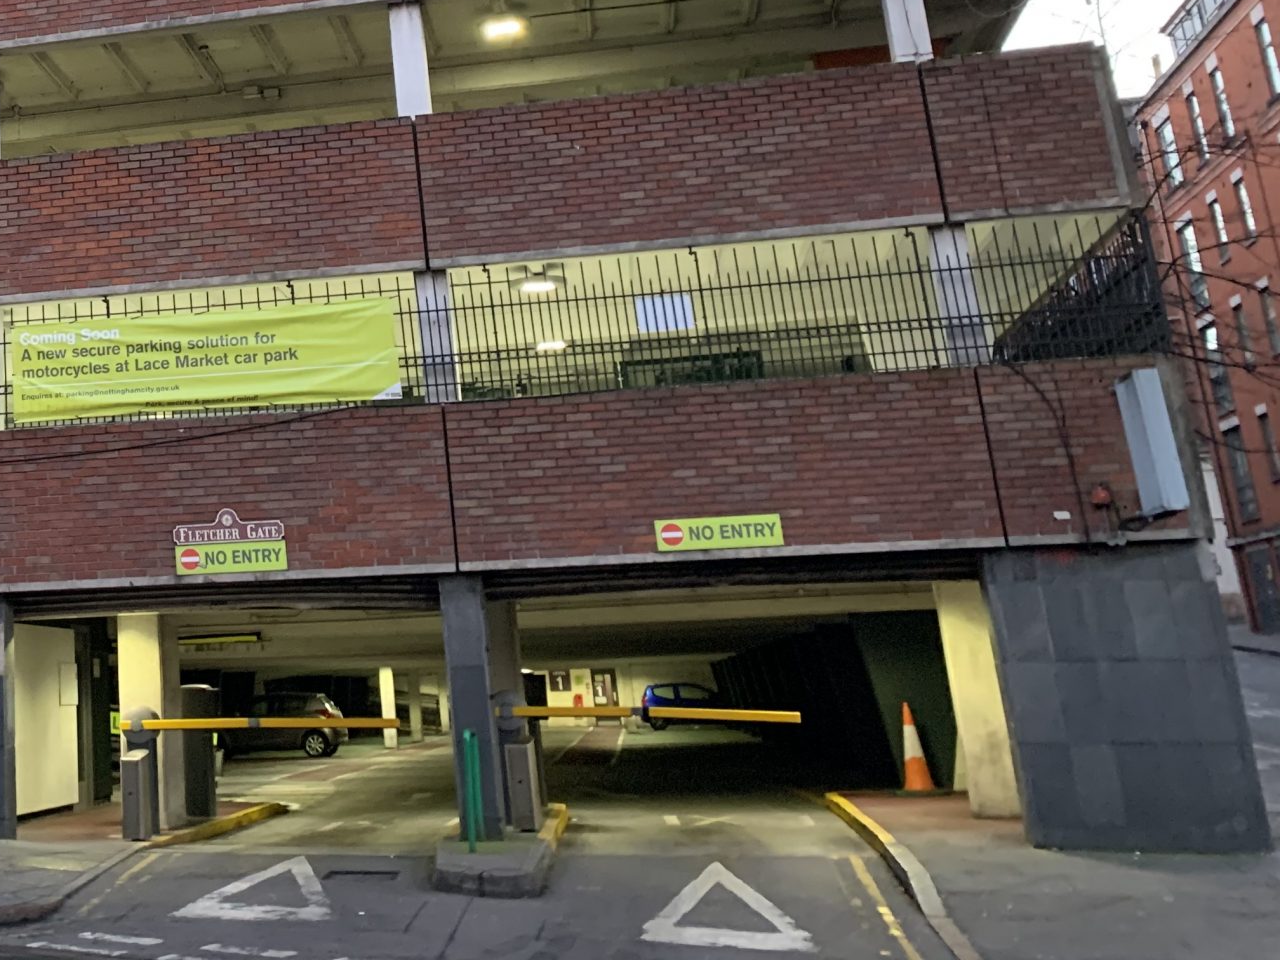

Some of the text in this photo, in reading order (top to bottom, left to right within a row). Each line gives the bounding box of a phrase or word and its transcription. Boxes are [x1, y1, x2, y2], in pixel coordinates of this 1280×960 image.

[19, 328, 119, 345] Coming Soon
[21, 331, 276, 362] A new secure parking solution for
[21, 347, 298, 378] motorcycles at Lace Market car park
[179, 524, 279, 542] FLETCHER GATE
[688, 522, 776, 541] NO ENTRY
[204, 547, 282, 565] NO ENTRY
[556, 676, 563, 690] 1
[596, 686, 603, 697] 1
